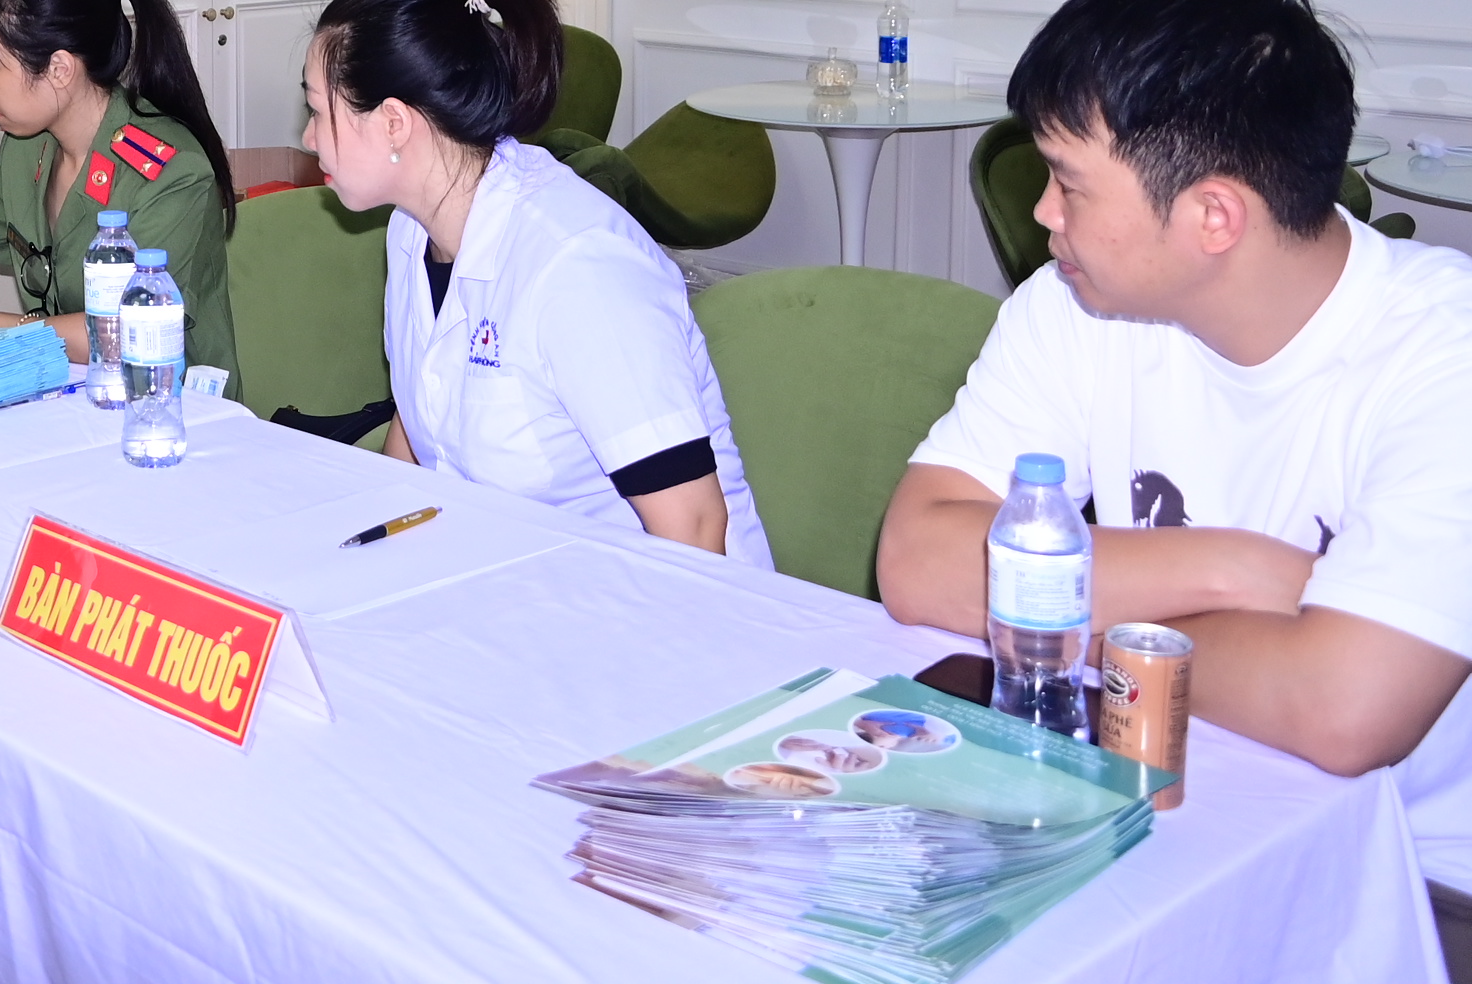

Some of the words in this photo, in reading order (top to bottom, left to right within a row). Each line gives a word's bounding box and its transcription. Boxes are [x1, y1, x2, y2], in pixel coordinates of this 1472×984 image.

[15, 561, 81, 636] BÀN
[70, 589, 156, 667] PHÁT
[147, 619, 251, 712] THUỐC
